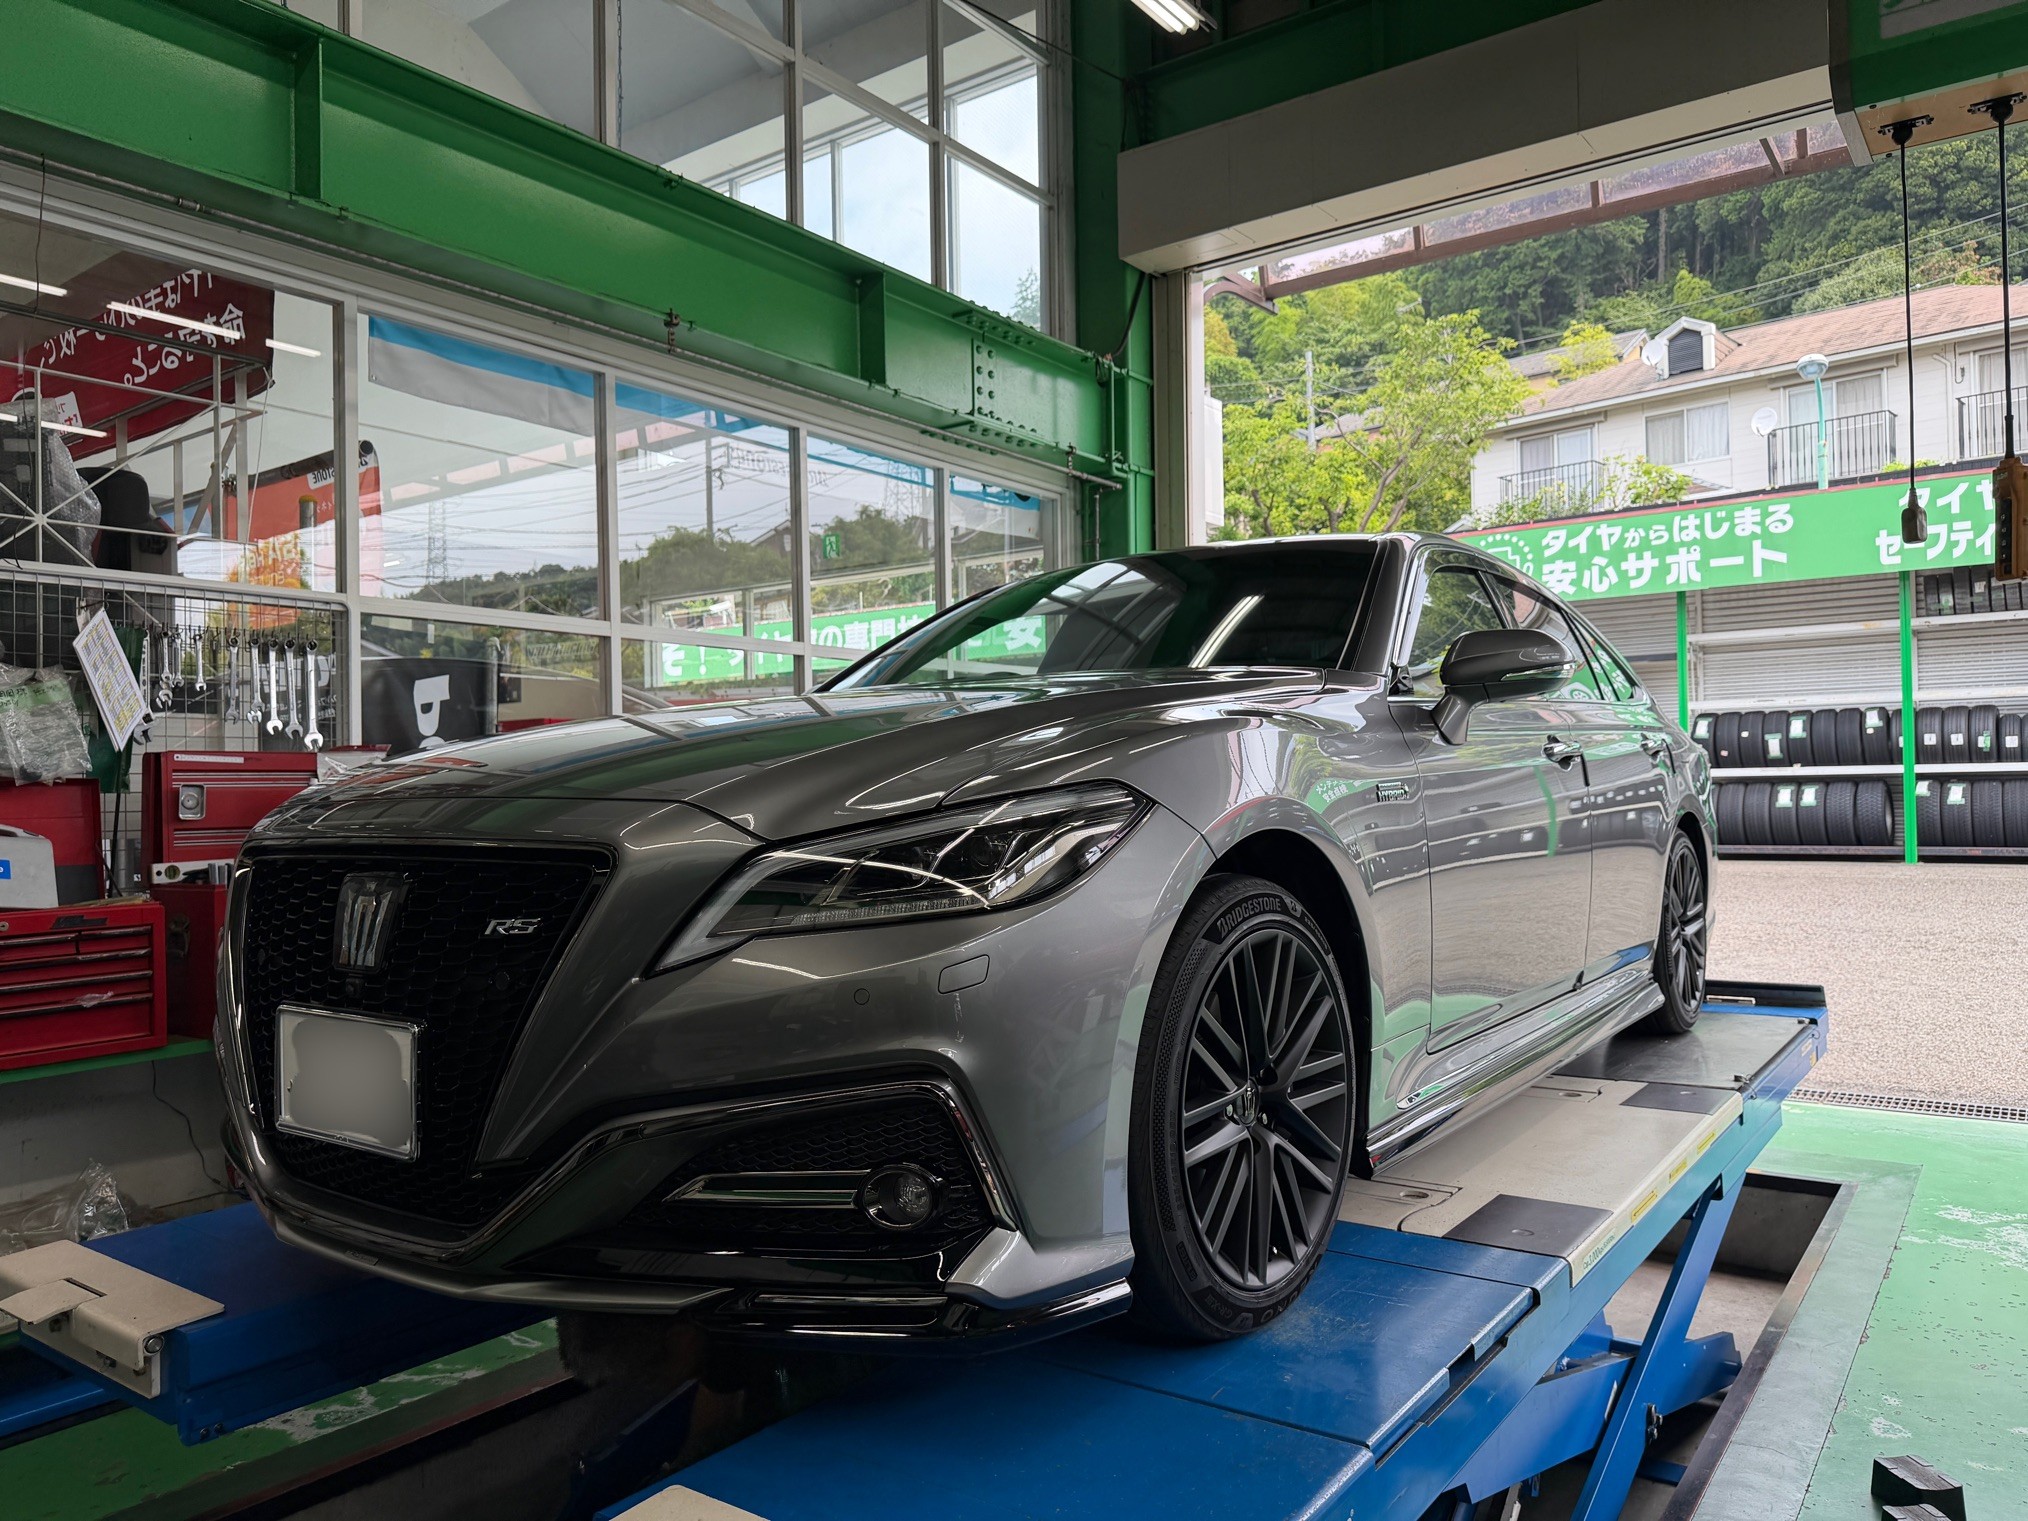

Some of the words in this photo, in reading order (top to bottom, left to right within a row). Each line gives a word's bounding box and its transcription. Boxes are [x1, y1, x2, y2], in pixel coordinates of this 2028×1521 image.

[1541, 503, 1795, 557] タイヤからはじまる
[1541, 538, 1789, 596] 安心サポート
[484, 917, 542, 935] RS
[1217, 897, 1282, 938] BRIDGESTONE
